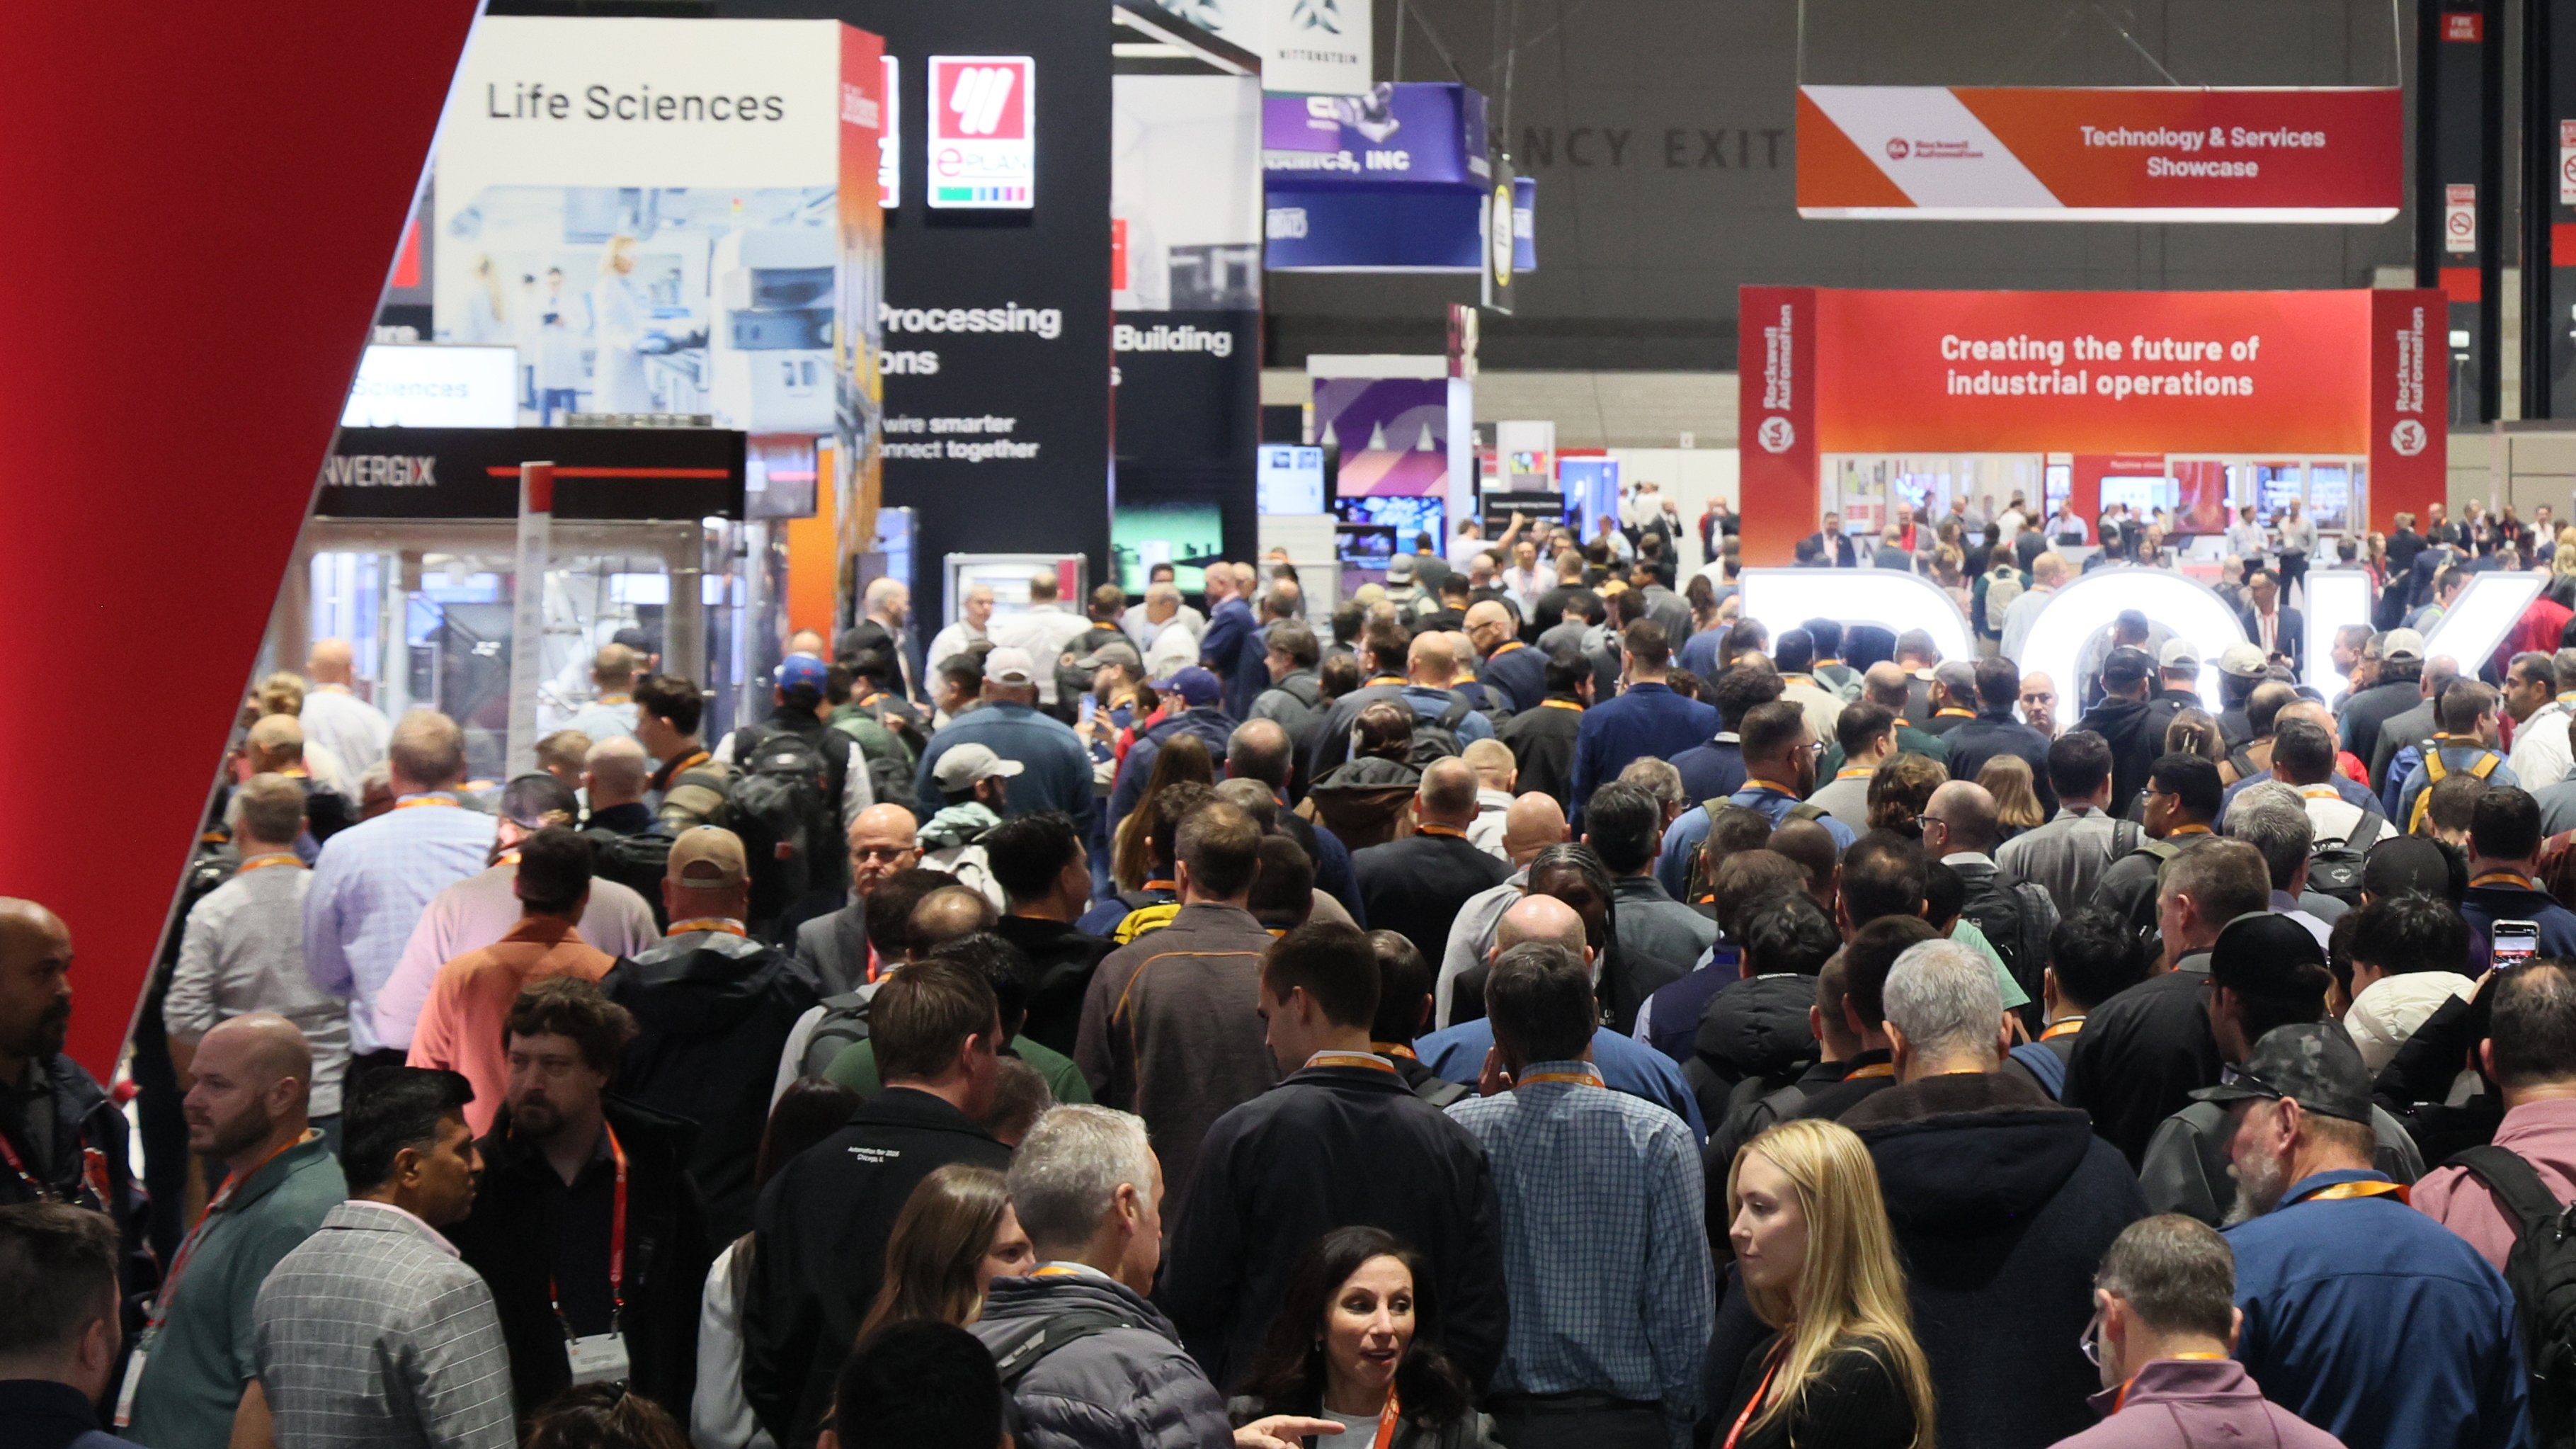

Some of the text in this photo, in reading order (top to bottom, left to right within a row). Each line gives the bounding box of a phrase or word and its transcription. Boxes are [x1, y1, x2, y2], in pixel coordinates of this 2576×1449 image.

[487, 83, 784, 121] Life Sciences
[1665, 127, 1784, 169] EXIT
[2080, 126, 2326, 152] Technology & Services
[1365, 149, 1410, 170] INC
[2146, 156, 2259, 177] Showcase
[879, 301, 1061, 339] Processing
[1113, 324, 1233, 358] Building
[1778, 304, 1792, 411] Automation
[1941, 334, 2260, 366] Creating the future of
[1762, 326, 1778, 409] Rockwell
[2395, 329, 2410, 412] Rockwell
[2410, 306, 2424, 414] Automation
[1947, 369, 2255, 401] industrial operations
[883, 414, 1017, 433] wire smarter
[946, 439, 1040, 462] together
